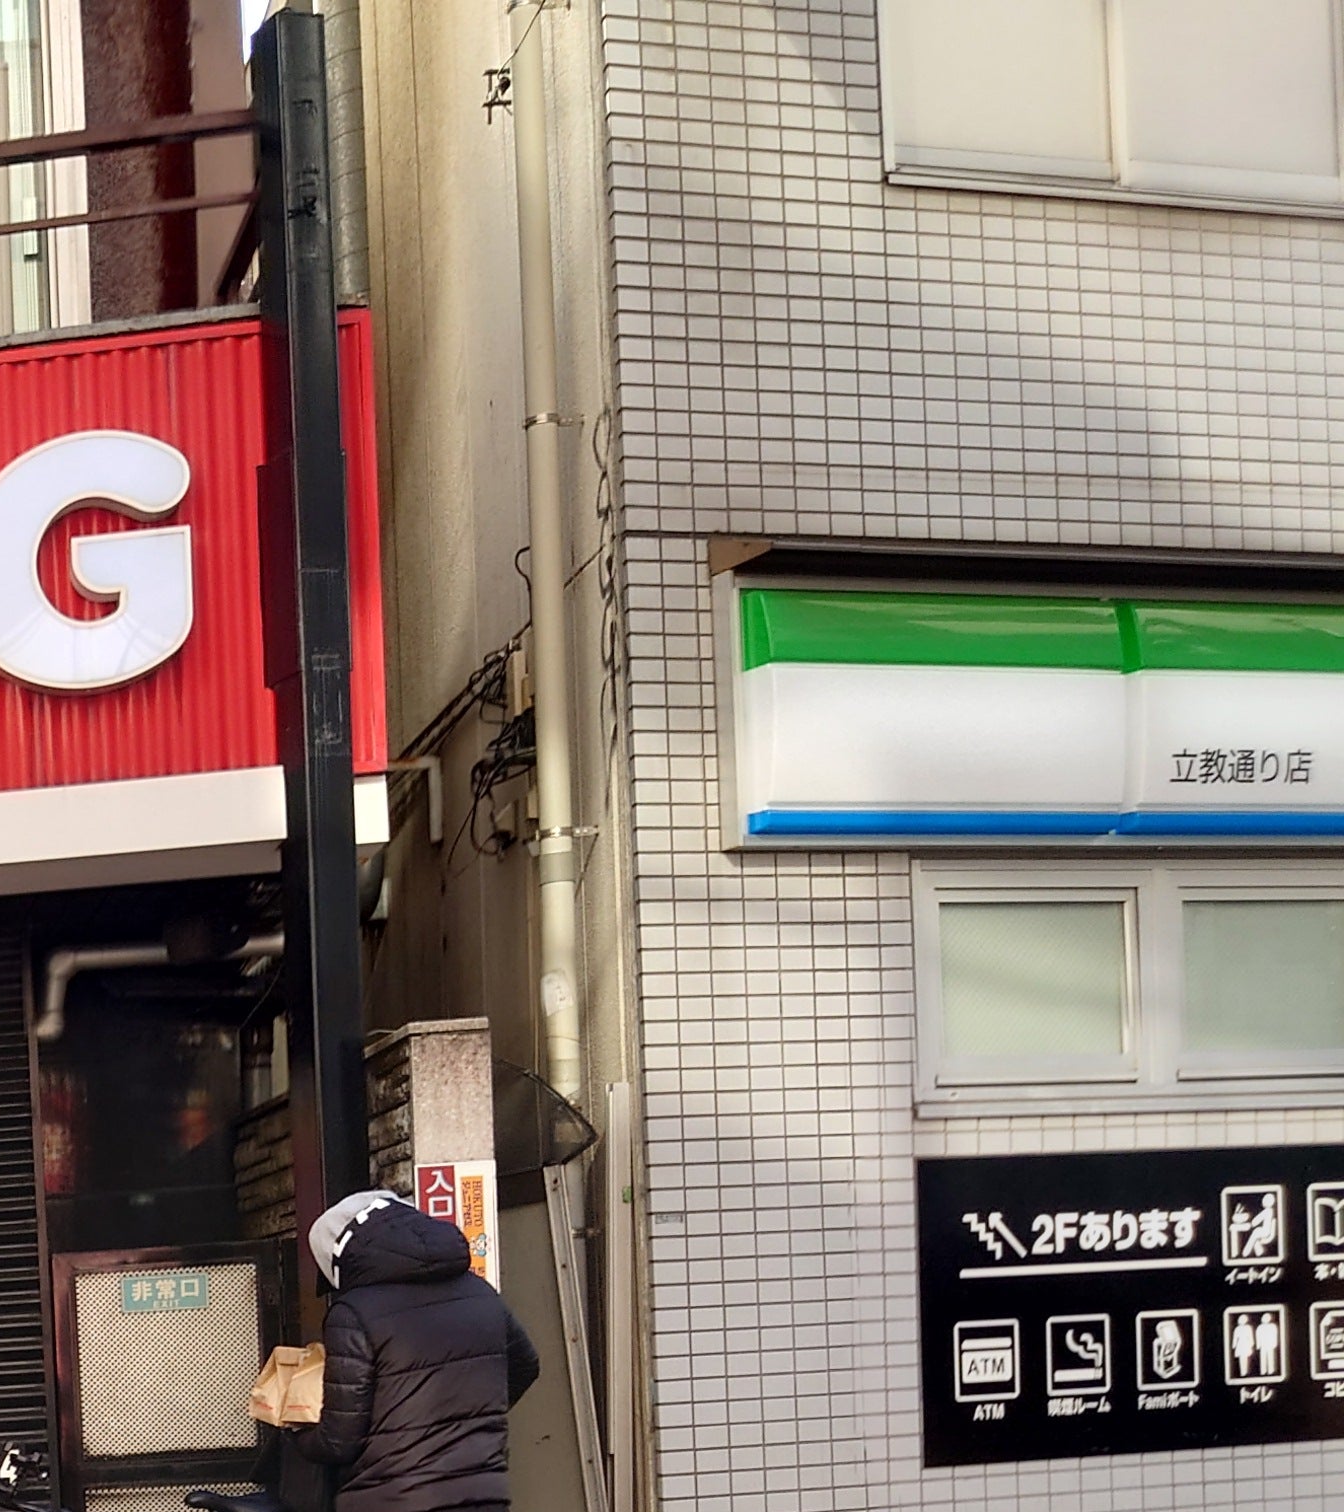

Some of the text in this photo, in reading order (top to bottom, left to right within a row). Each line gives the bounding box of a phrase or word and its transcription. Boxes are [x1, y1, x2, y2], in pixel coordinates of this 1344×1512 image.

[1169, 748, 1313, 785] 立教通り店
[425, 1170, 454, 1217] 入口
[1030, 1207, 1201, 1256] 2Fあります
[1224, 1266, 1284, 1286] イートイン
[131, 1279, 200, 1302] 非常口
[152, 1299, 180, 1309] EXIT
[967, 1357, 1006, 1376] ATM
[1239, 1385, 1275, 1405] トイレ
[972, 1402, 1007, 1422] ATM
